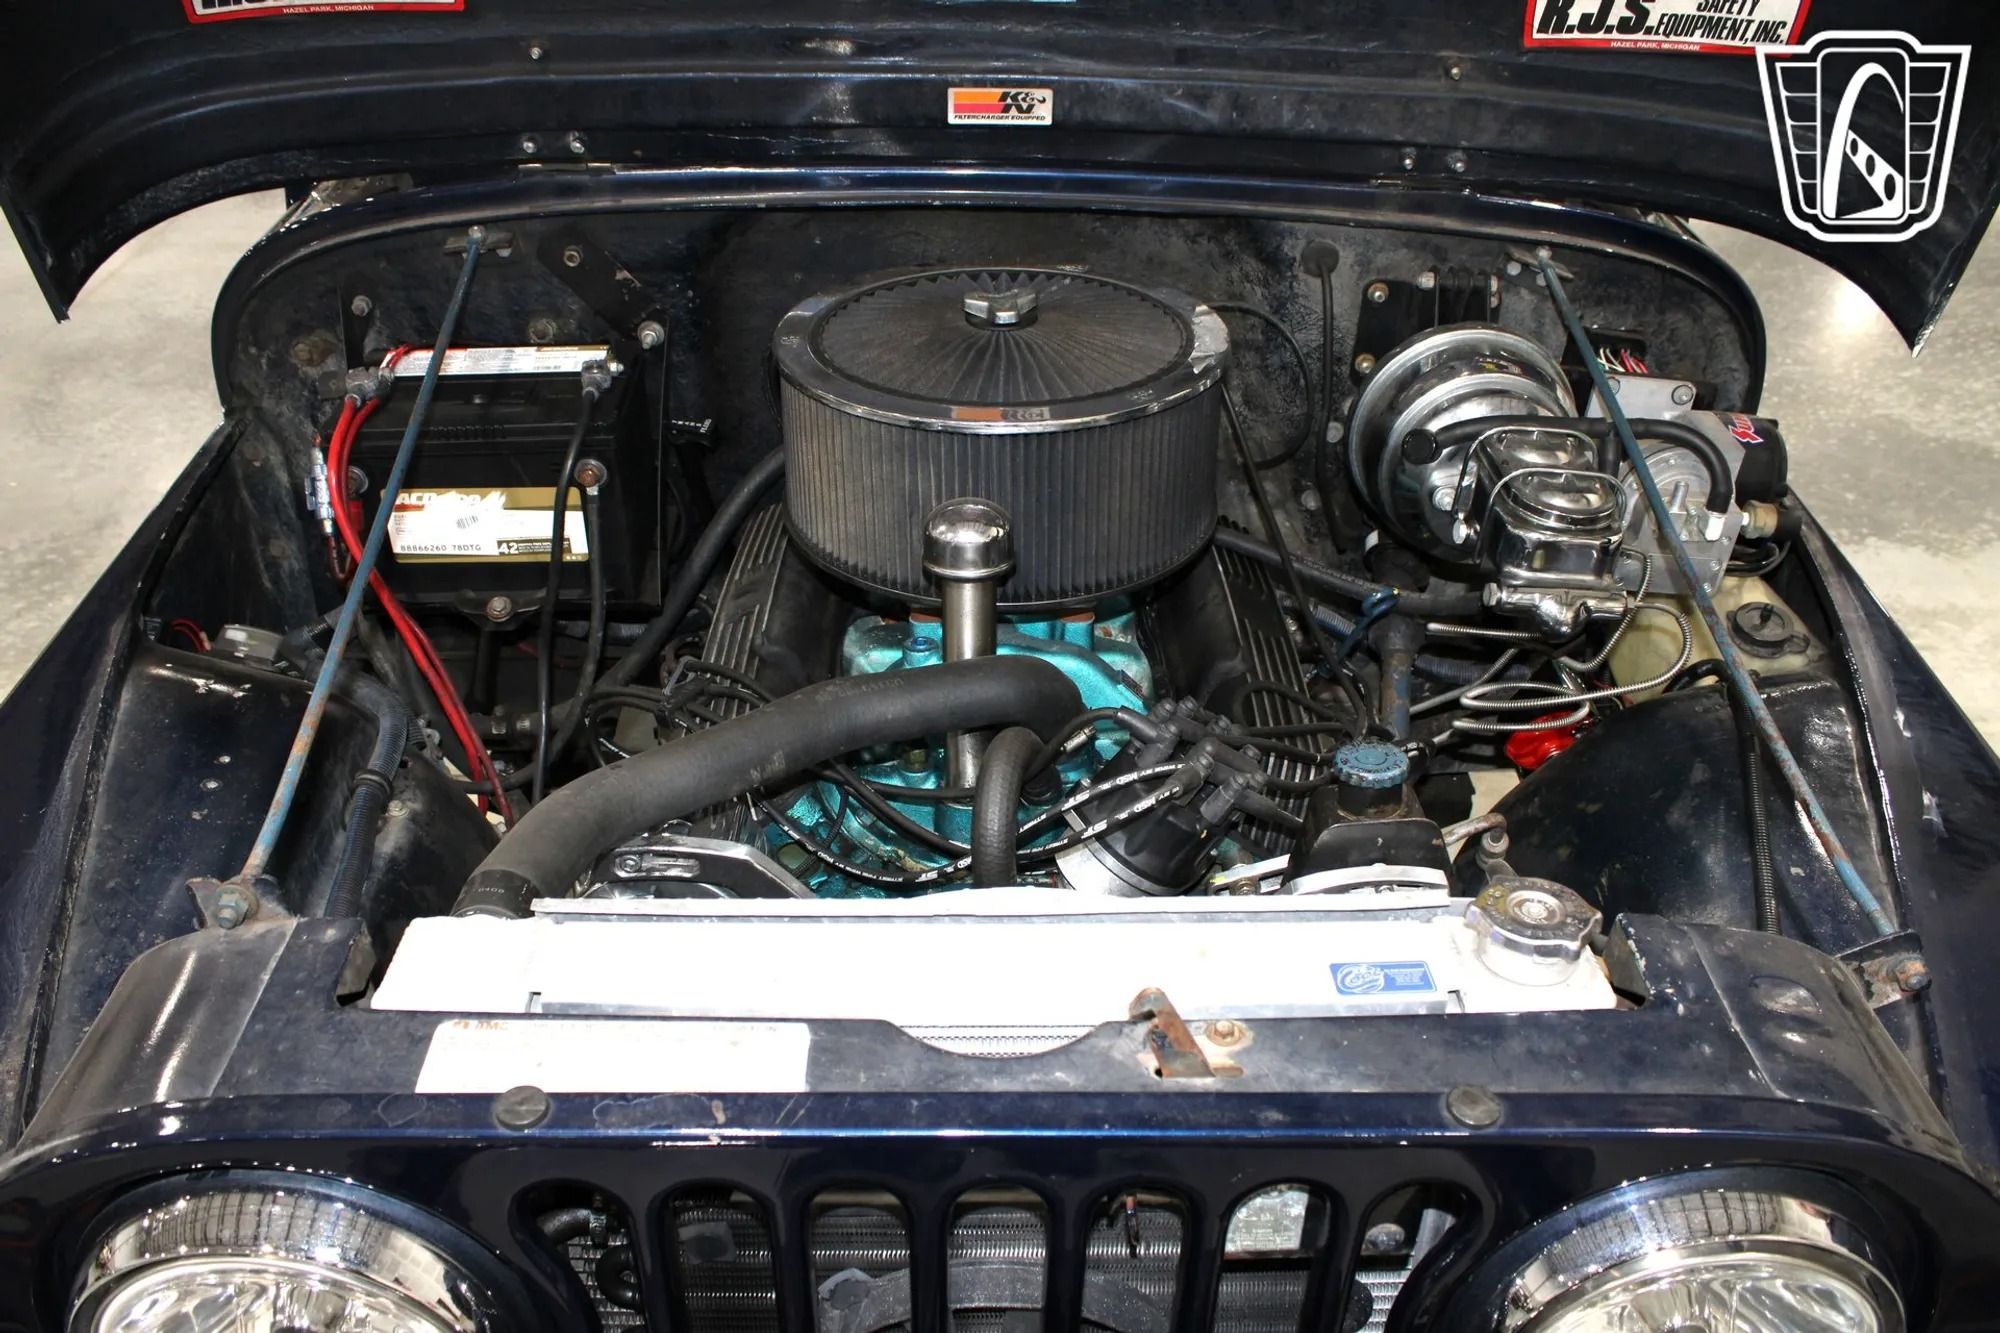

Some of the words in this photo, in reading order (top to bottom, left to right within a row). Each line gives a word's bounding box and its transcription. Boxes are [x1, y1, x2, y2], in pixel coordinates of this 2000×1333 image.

[335, 4, 374, 12] MICHIGAN
[1637, 41, 1660, 49] PARK,
[1661, 42, 1700, 51] MICHIGAN
[498, 542, 519, 554] 42
[1116, 772, 1139, 785] MSD
[1134, 797, 1157, 813] MSD
